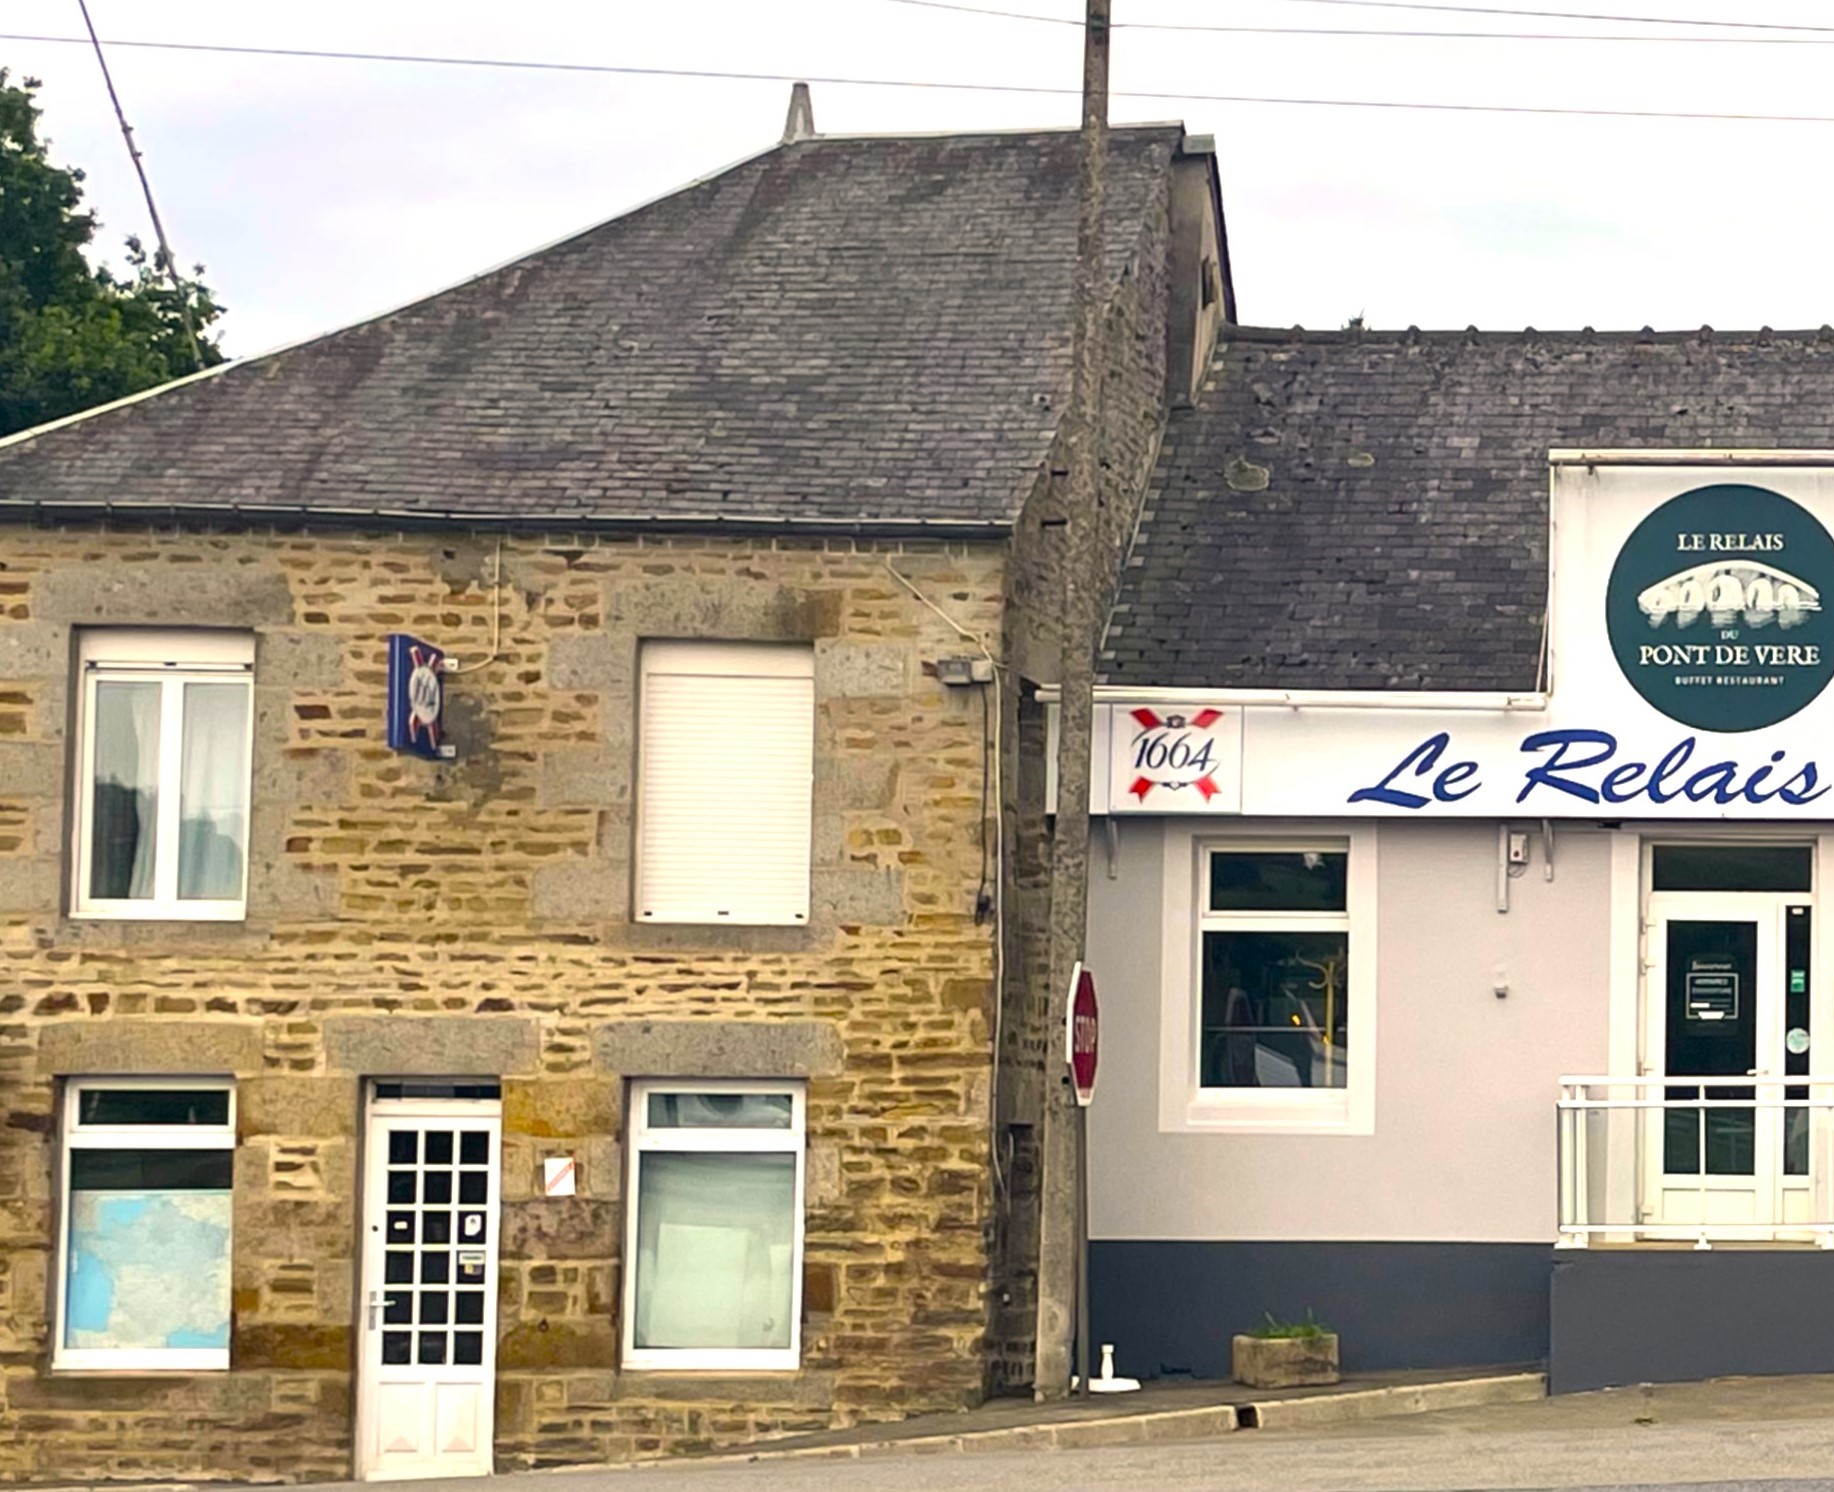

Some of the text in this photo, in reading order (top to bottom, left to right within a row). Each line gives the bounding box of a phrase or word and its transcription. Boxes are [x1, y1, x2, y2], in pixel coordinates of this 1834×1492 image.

[1676, 533, 1784, 551] LE RELAIS
[1720, 629, 1739, 640] DU
[1638, 644, 1821, 666] PONT DE VERE
[1674, 675, 1784, 686] BUFFET RESTAURANT
[1133, 731, 1216, 773] 1664
[1347, 732, 1481, 810] Le
[1517, 728, 1833, 806] Relais
